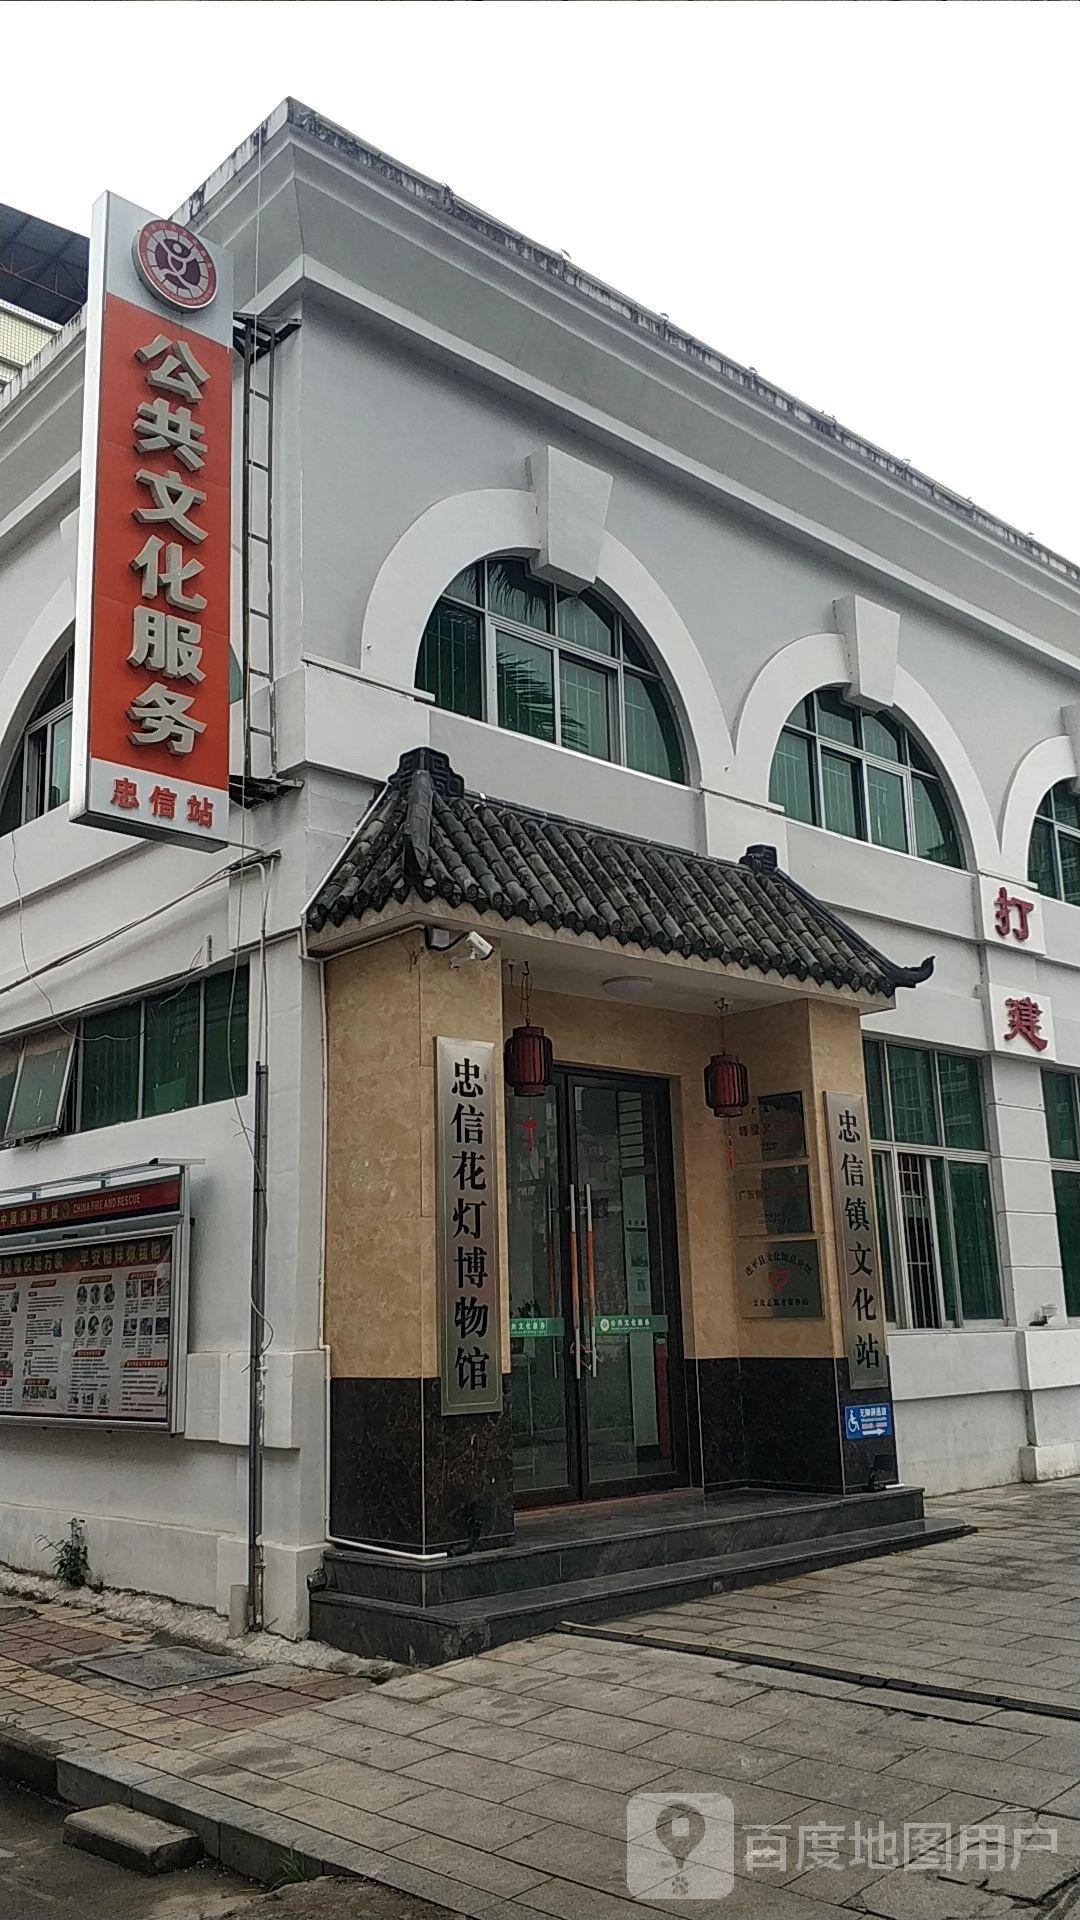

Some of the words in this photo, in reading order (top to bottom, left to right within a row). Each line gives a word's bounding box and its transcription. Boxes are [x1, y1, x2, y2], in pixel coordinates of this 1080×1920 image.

[127, 333, 210, 756] 公共文化服务
[110, 777, 214, 829] 忠信站
[994, 886, 1035, 941] 打
[1, 1204, 59, 1226] 中国消防救援
[73, 1202, 90, 1214] CHINA
[91, 1199, 103, 1211] FIRE
[104, 1197, 117, 1209] AND
[117, 1193, 141, 1206] RESCUE
[450, 1057, 489, 1392] 忠信花灯博物馆
[837, 1109, 880, 1370] 忠信镇文化站
[610, 1318, 650, 1327] 公共文化服务
